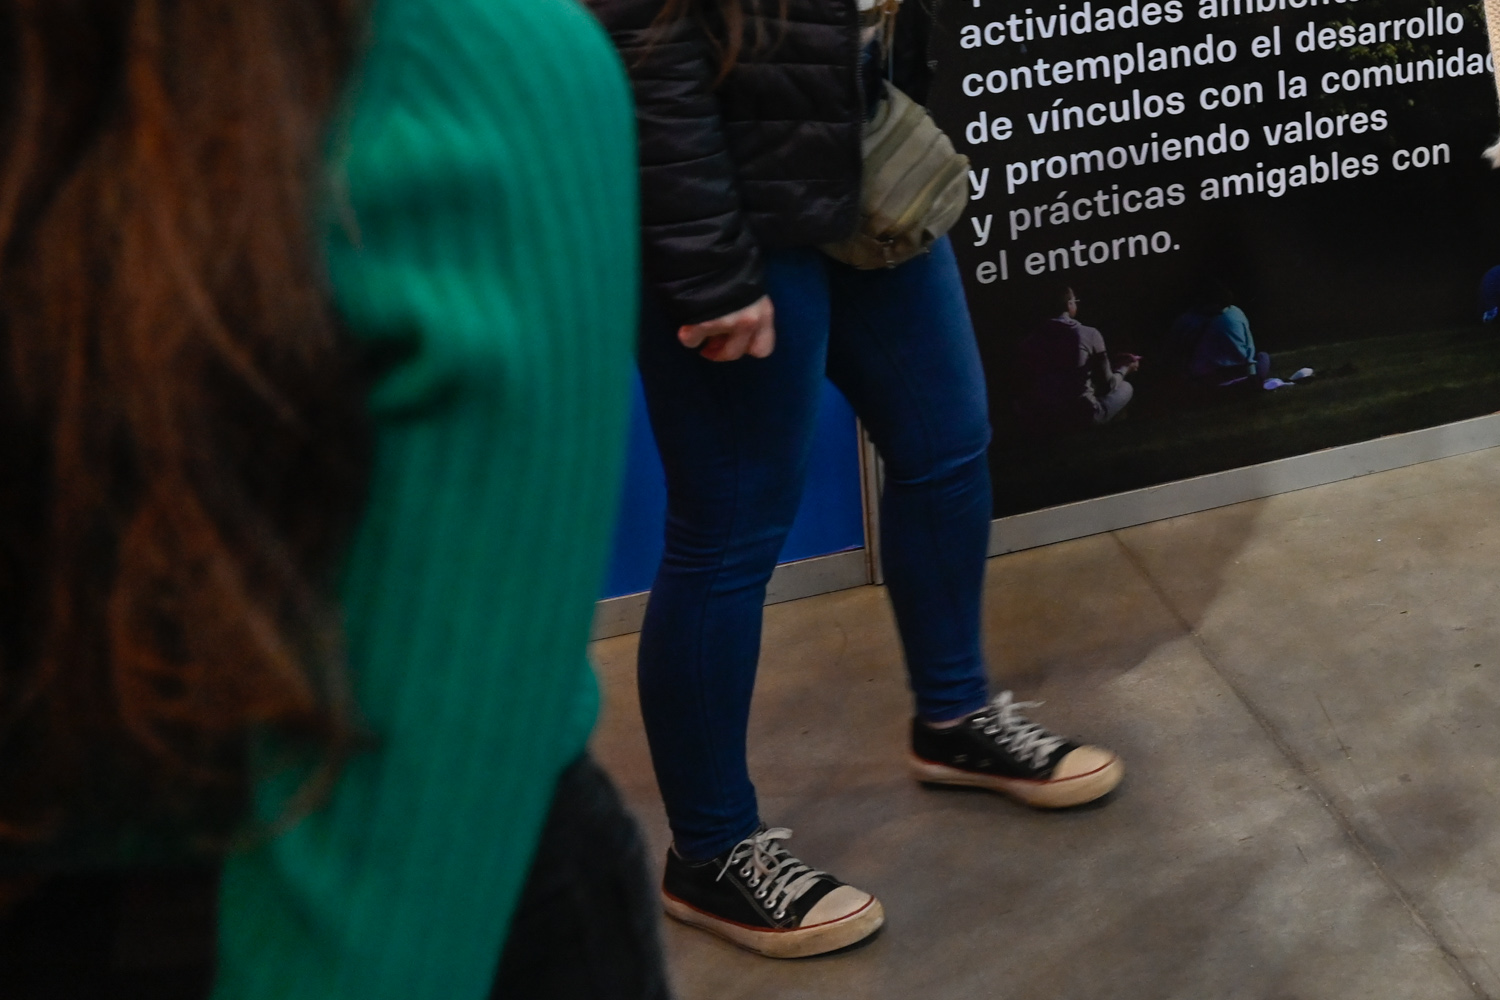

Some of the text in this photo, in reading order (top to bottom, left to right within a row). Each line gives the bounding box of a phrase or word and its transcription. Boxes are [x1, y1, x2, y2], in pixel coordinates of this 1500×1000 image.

[962, 7, 1463, 97] contemplando el desarrollo
[966, 111, 1012, 144] de
[1028, 89, 1185, 134] vínculos
[1200, 82, 1263, 110] con
[1279, 70, 1306, 99] la
[967, 110, 1387, 200] y promoviendo valores
[971, 144, 1449, 246] y prácticas amigables con
[976, 231, 1179, 283] el entorno.
